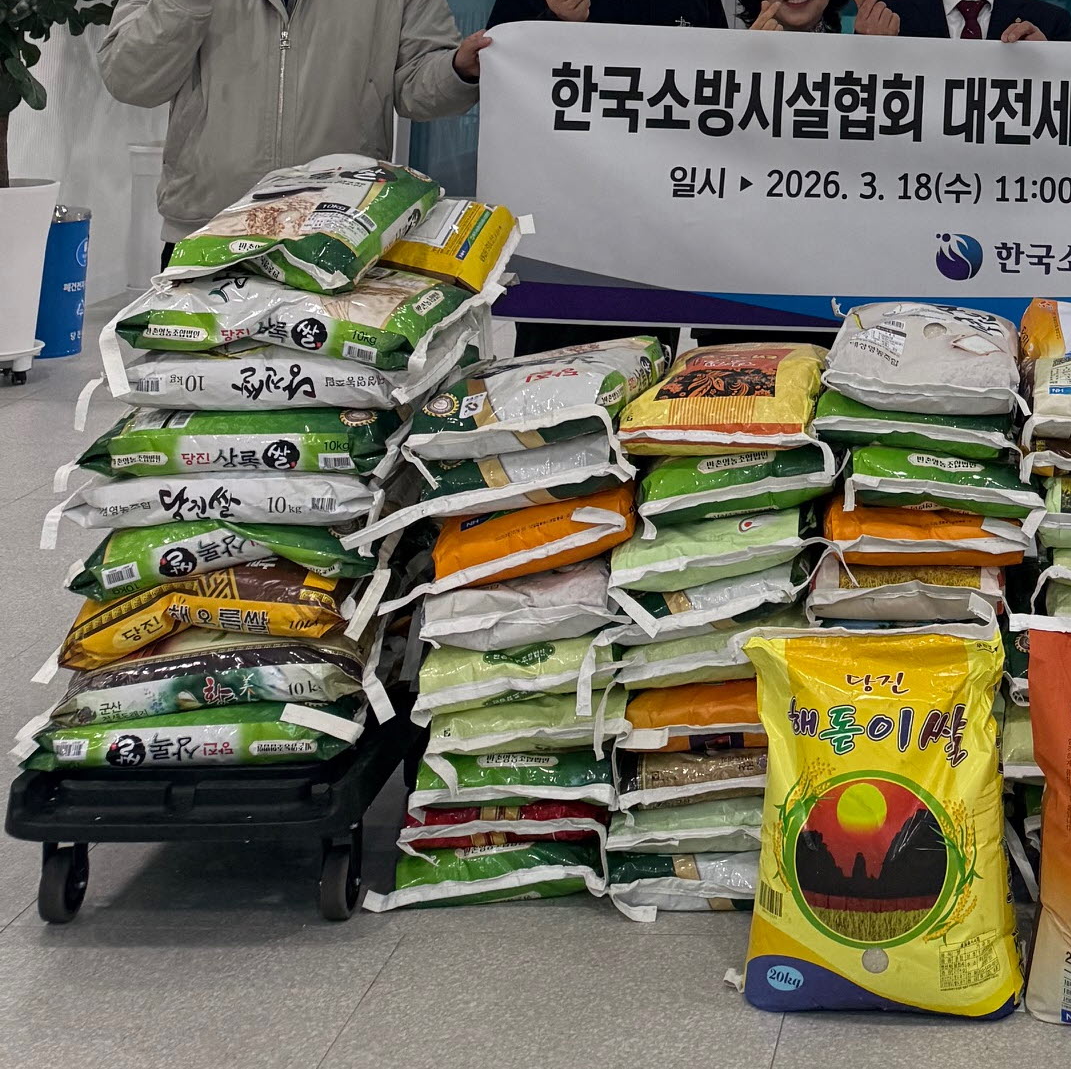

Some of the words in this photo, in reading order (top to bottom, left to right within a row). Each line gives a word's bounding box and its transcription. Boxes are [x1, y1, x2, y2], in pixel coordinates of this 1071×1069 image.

[551, 62, 924, 143] 한국소방시설협회
[670, 166, 726, 199] 일시
[766, 169, 848, 201] 2026.
[860, 172, 885, 201] 3.
[898, 172, 982, 205] 18(수)
[296, 318, 323, 349] 쌀
[351, 330, 377, 345] 10kg
[169, 374, 185, 389] kg
[186, 375, 205, 392] 10
[231, 363, 317, 401] 당진쌀
[181, 452, 211, 465] 당진
[213, 448, 262, 470] 상록
[264, 442, 296, 469] 쌀
[324, 440, 350, 453] 10kg
[159, 486, 241, 521] 당진쌀
[266, 495, 287, 514] 10
[288, 504, 302, 515] kg
[121, 617, 164, 641] 당진
[168, 600, 271, 634] 해오름쌀
[287, 683, 305, 696] 10
[846, 672, 910, 695] 당진
[99, 700, 123, 717] 군산
[150, 735, 201, 762] 상록
[203, 740, 235, 757] 당진
[768, 967, 802, 990] 20kg
